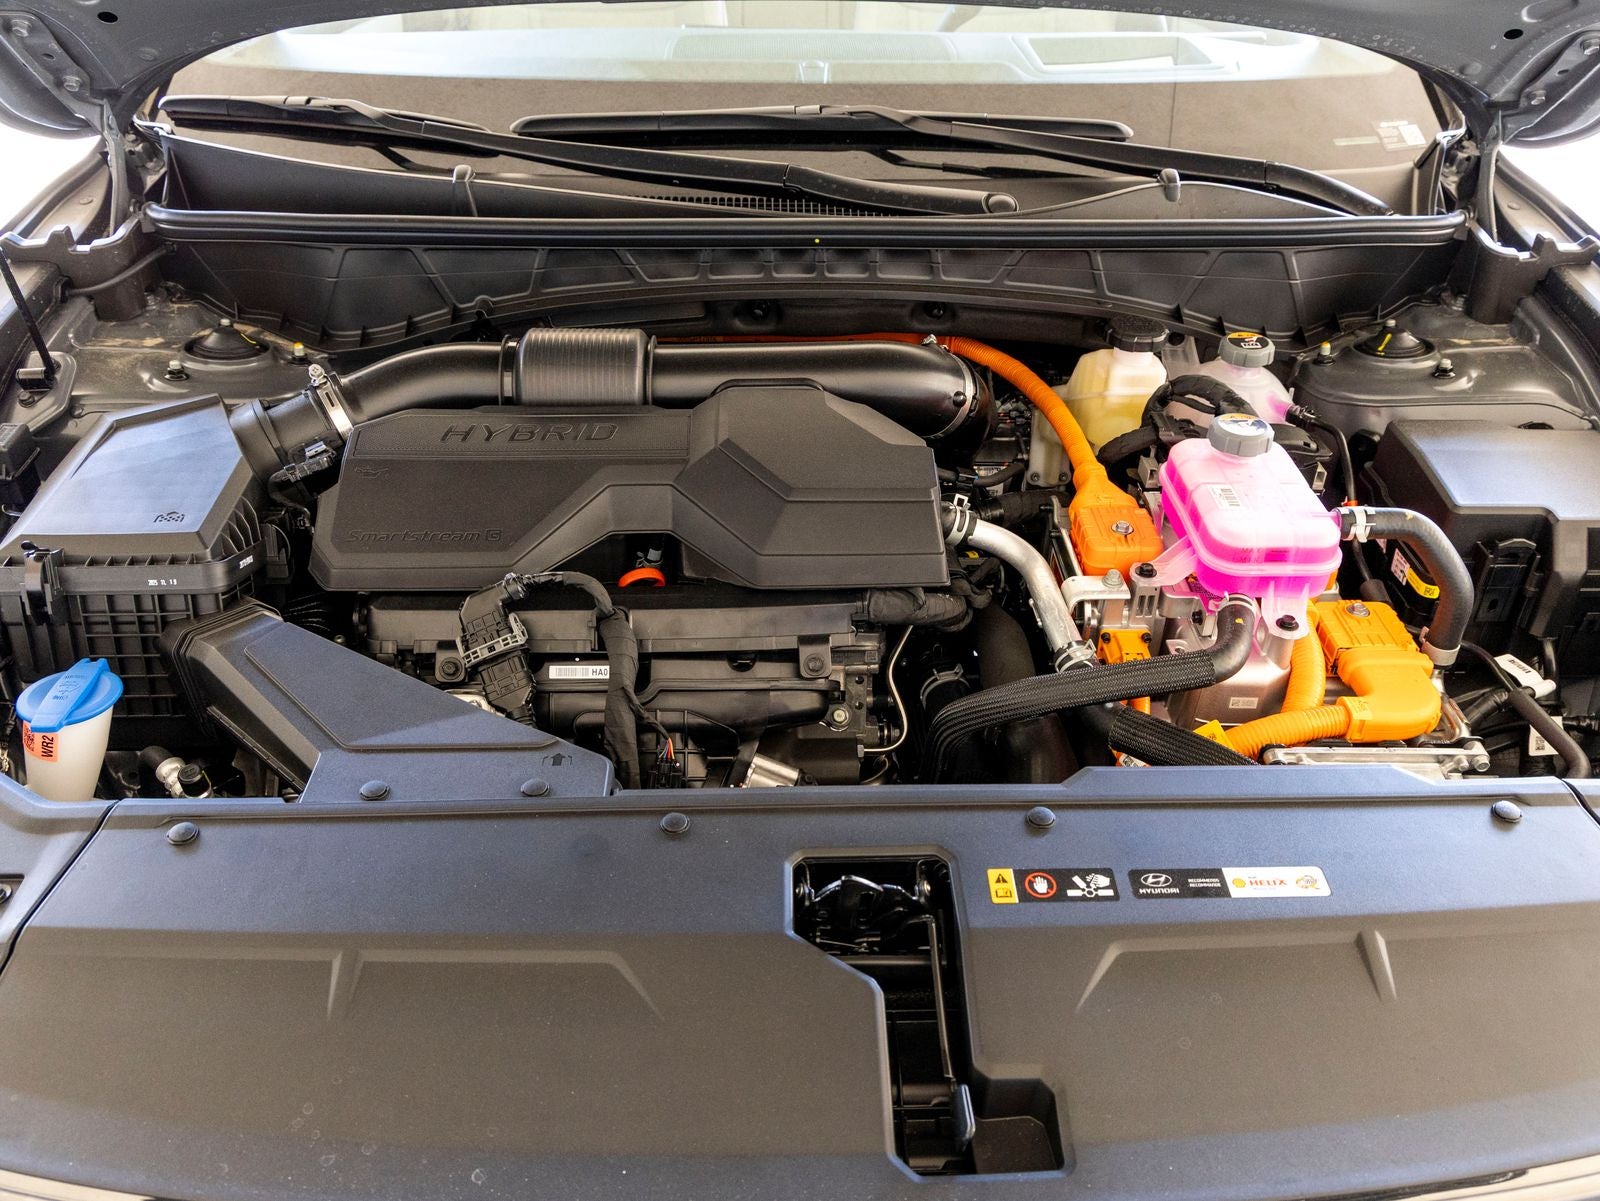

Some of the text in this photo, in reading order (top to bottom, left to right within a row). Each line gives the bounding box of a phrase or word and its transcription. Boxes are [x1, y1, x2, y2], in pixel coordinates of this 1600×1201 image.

[439, 423, 619, 442] HYBRID
[349, 529, 481, 542] Smartstream
[41, 735, 54, 758] WR2
[1249, 878, 1288, 886] HELIX
